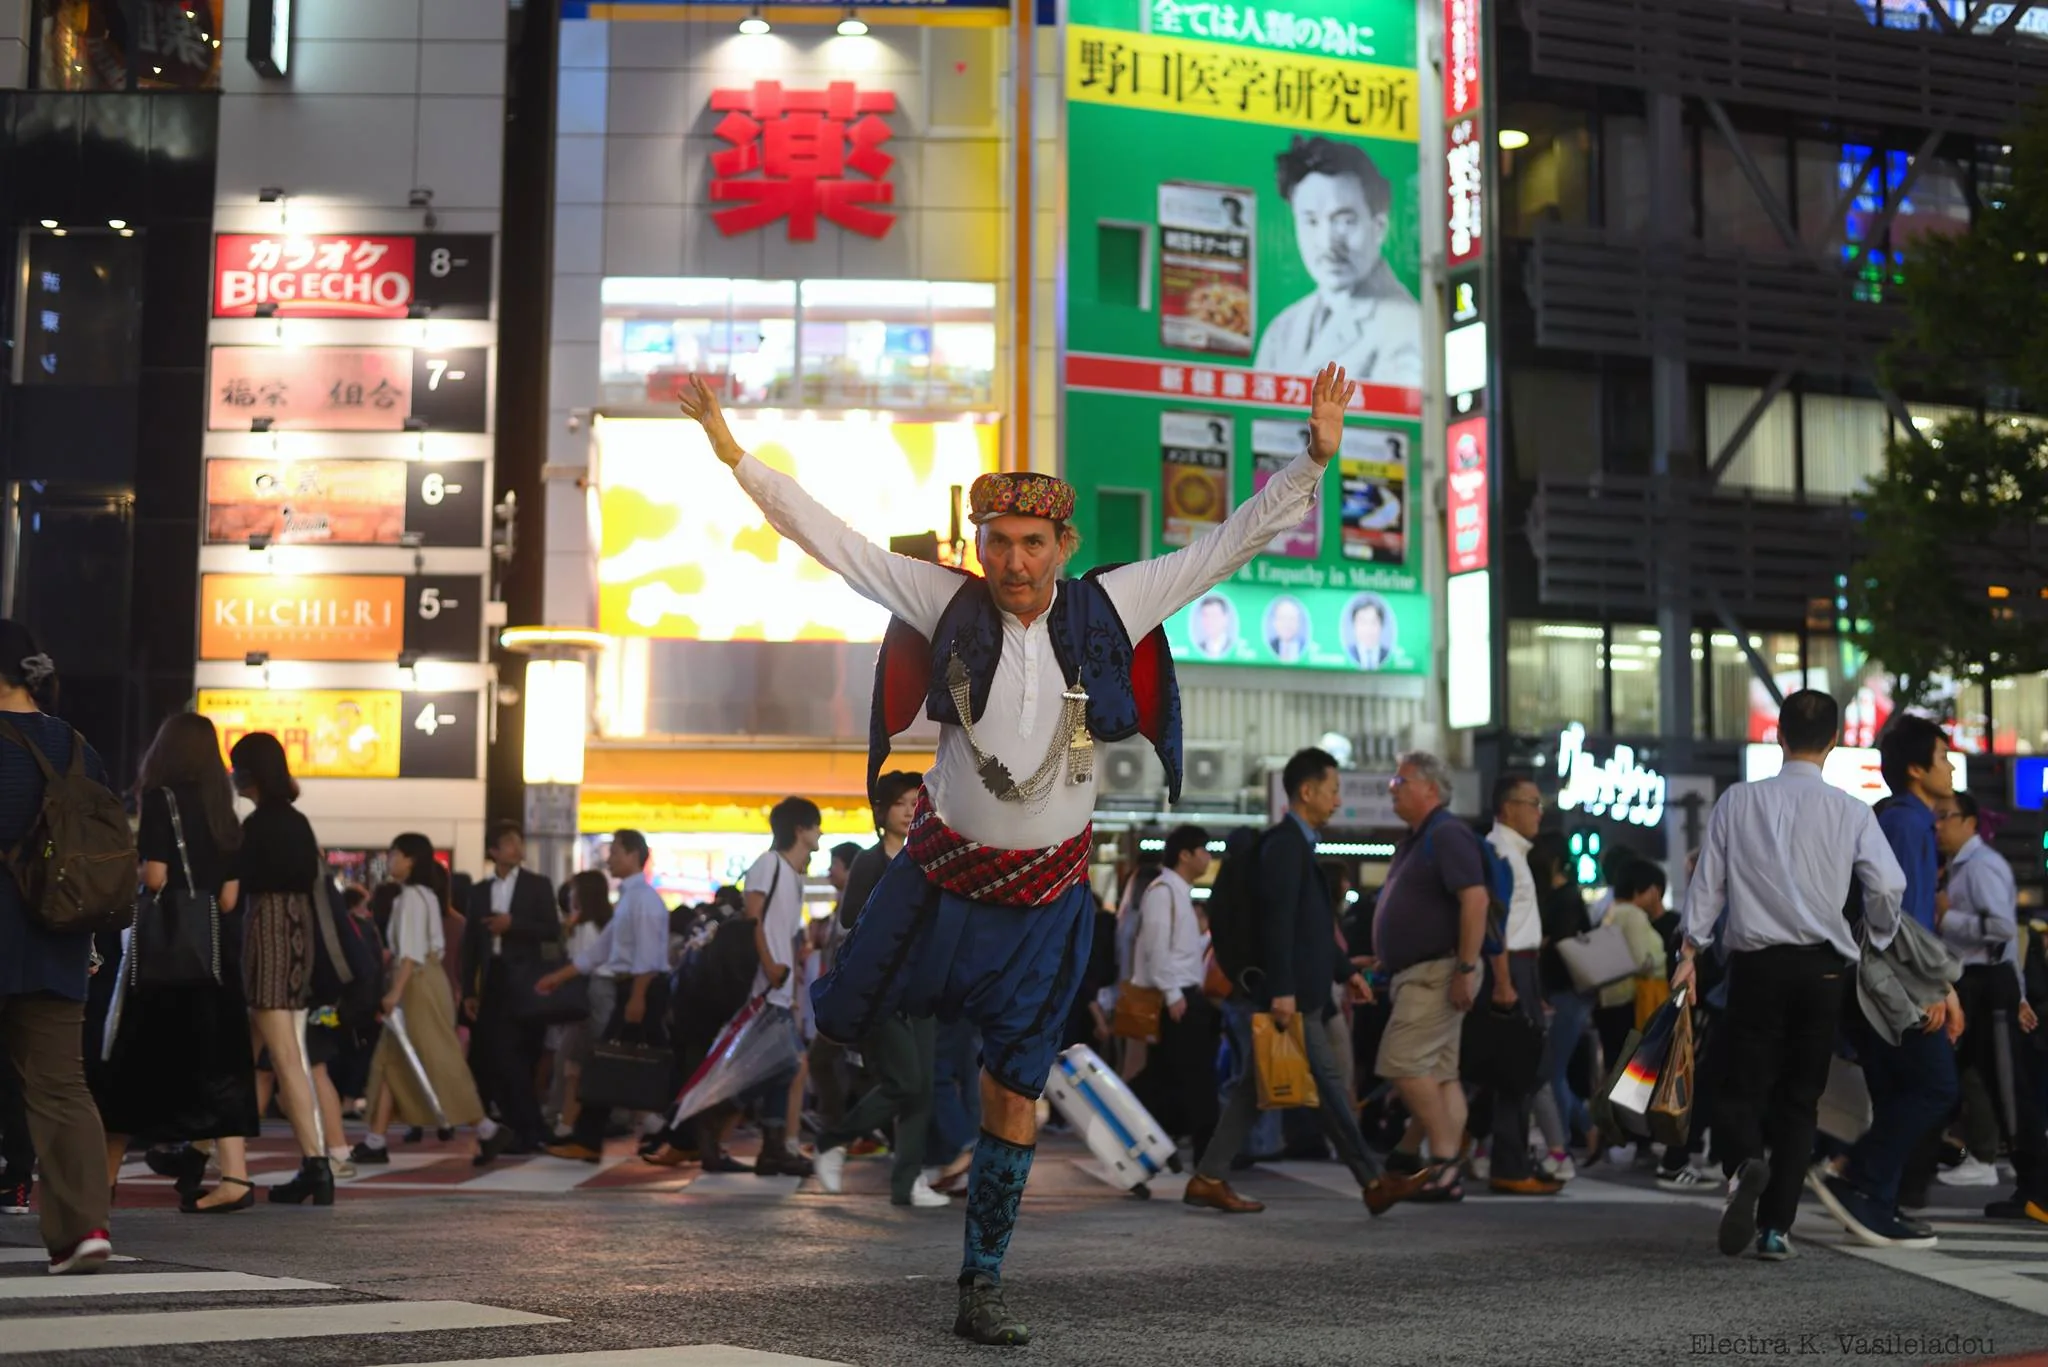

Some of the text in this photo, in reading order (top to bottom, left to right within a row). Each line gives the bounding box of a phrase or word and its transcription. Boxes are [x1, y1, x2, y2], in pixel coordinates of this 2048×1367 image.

[1152, 0, 1376, 56] 全ては人類の為に
[1079, 38, 1408, 131] 野口医学研究所
[710, 79, 897, 241] 薬
[247, 239, 388, 271] カラオケ
[221, 270, 410, 309] BIG ECHO
[1257, 561, 1325, 588] Empathy
[1350, 567, 1417, 591] Medicine
